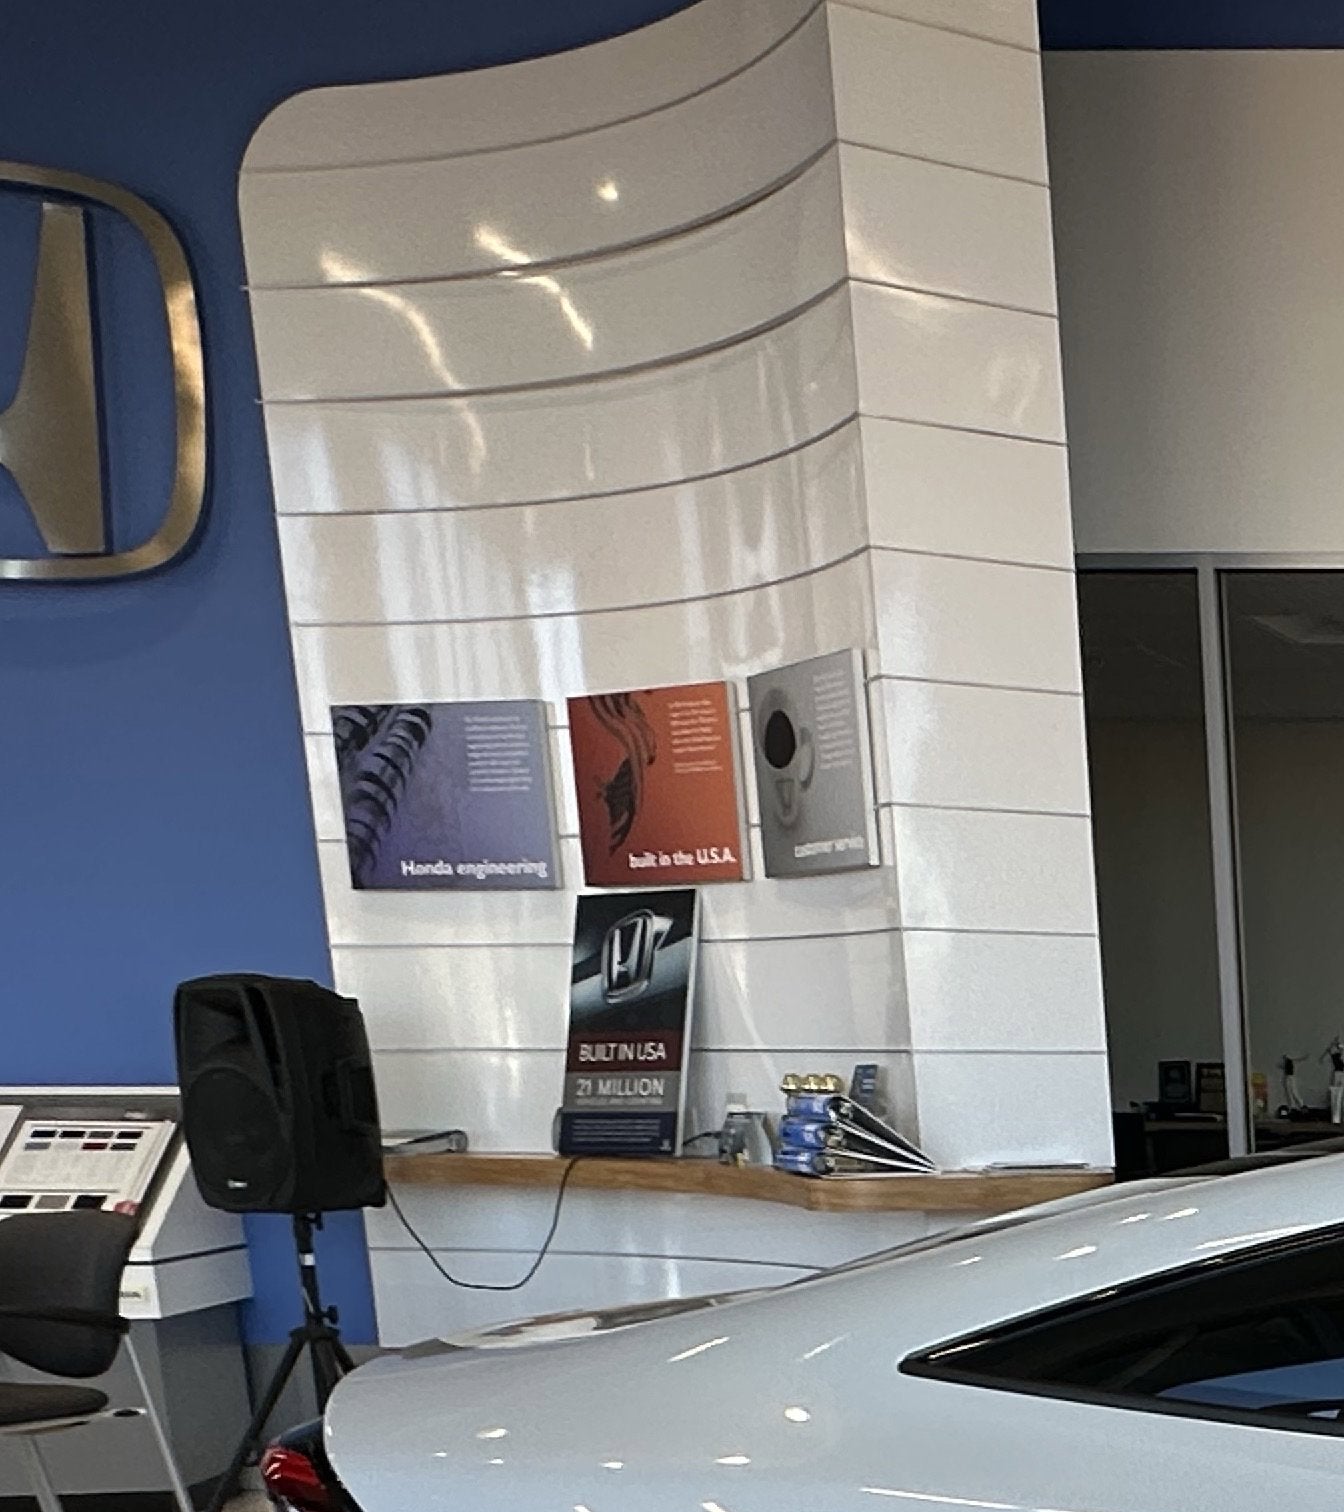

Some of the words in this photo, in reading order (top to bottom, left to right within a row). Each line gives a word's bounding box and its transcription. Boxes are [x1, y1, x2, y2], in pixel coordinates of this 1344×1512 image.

[400, 860, 453, 876] Honda
[456, 858, 548, 880] engineering
[628, 851, 657, 869] built
[578, 1043, 618, 1062] BUILT
[618, 1043, 635, 1061] IN
[636, 1042, 667, 1061] USA
[576, 1078, 592, 1096] 21
[597, 1078, 665, 1096] MILLION
